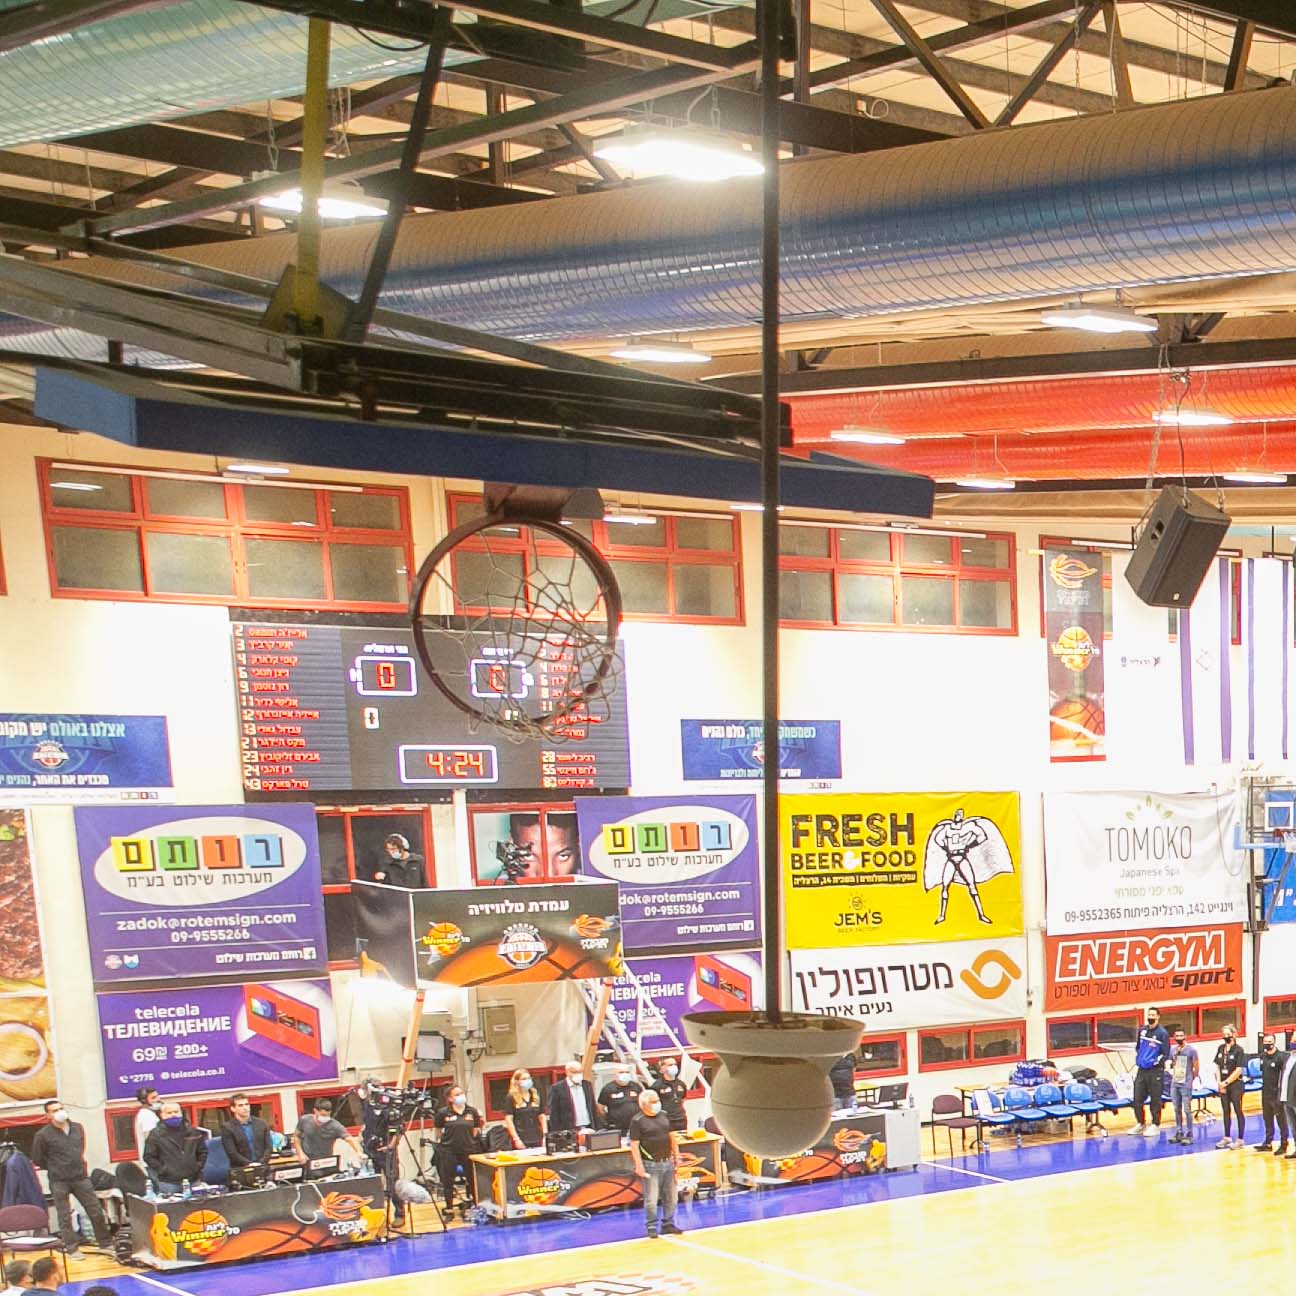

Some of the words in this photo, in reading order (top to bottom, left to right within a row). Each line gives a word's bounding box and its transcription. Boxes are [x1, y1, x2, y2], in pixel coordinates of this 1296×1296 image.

[377, 662, 395, 689] 0
[31, 722, 47, 737] יש
[51, 721, 88, 737] באולם
[90, 722, 125, 737] אצלנו
[427, 751, 483, 776] 4:24
[610, 824, 723, 848] רותם
[791, 812, 915, 849] FRESH
[1105, 825, 1192, 862] TOMOKO
[122, 838, 271, 865] רותם
[648, 855, 679, 868] שילוט
[790, 852, 844, 870] BEER
[861, 850, 916, 868] FOOD
[173, 873, 214, 887] שילוט
[1120, 867, 1162, 879] Japanese
[467, 902, 525, 916] טלוויזיה
[528, 899, 570, 913] עמדת
[644, 903, 704, 917] 09-9555266
[1124, 907, 1150, 919] פיתוח
[1152, 904, 1184, 917] הרצליה
[1186, 902, 1205, 915] 142,
[117, 912, 297, 931] zadok@rotemsign.com
[834, 909, 883, 926] JEM'S
[1065, 907, 1121, 922] 09-9552365
[171, 929, 250, 943] 09-9555266
[1055, 930, 1225, 982] ENERGYM
[796, 962, 954, 1011] מטרופולין
[1122, 979, 1142, 992] ציוד
[1171, 967, 1235, 991] sport
[1054, 984, 1090, 998] וספורט
[135, 1004, 200, 1020] telecola
[860, 1001, 893, 1015] נעים
[103, 1016, 231, 1039] ТЕЛЕВИДЕНИЕ
[174, 1043, 208, 1056] 200+
[517, 1184, 560, 1197] Winner
[170, 1228, 226, 1244] Winner
